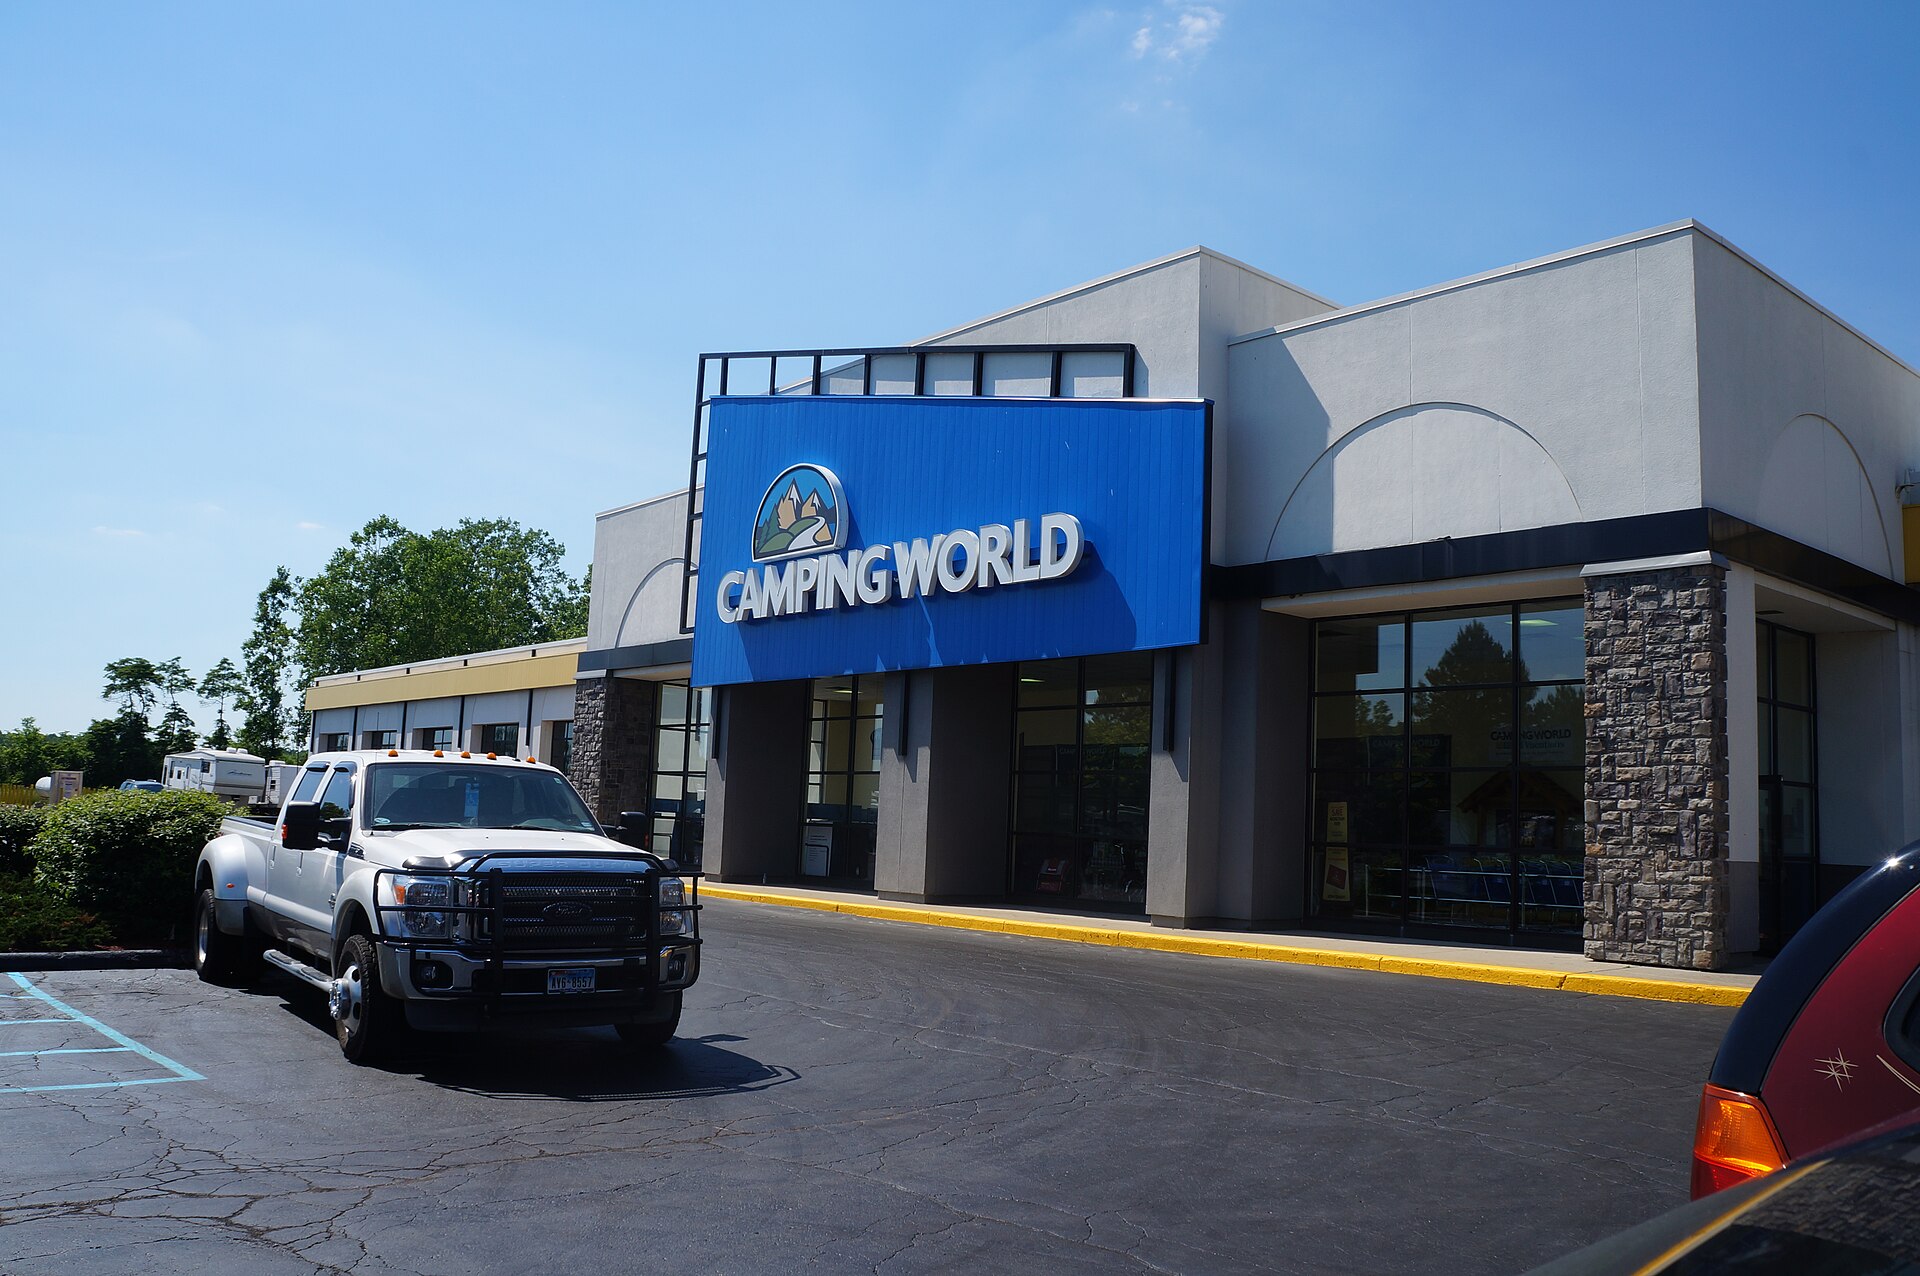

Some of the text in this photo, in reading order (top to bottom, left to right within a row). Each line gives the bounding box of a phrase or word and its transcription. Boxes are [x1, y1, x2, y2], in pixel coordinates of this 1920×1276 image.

[717, 512, 1084, 623] CAMPING WORLD
[1490, 729, 1571, 740] CAMNG WORLD
